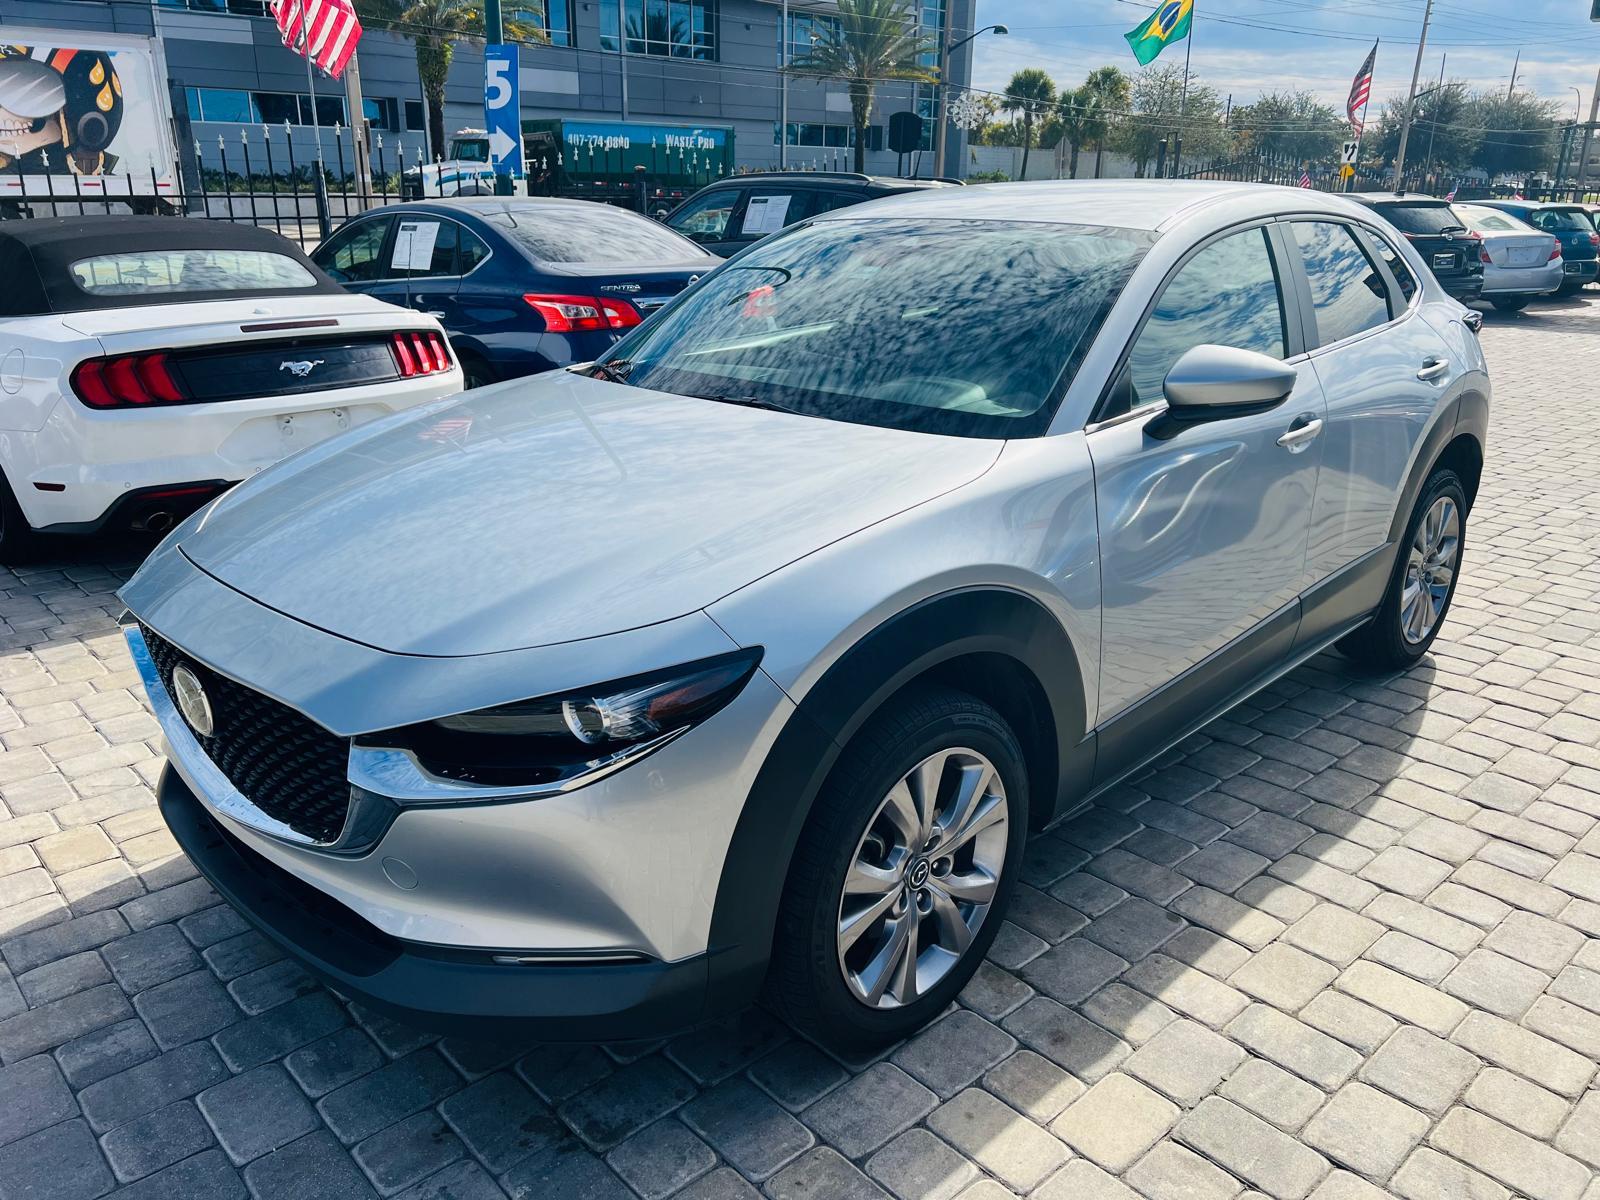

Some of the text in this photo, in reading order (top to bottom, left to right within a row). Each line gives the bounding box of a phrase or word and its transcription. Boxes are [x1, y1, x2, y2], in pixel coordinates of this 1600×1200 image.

[485, 60, 513, 110] 5
[665, 134, 695, 149] WASTE
[600, 284, 641, 294] SENTRA
